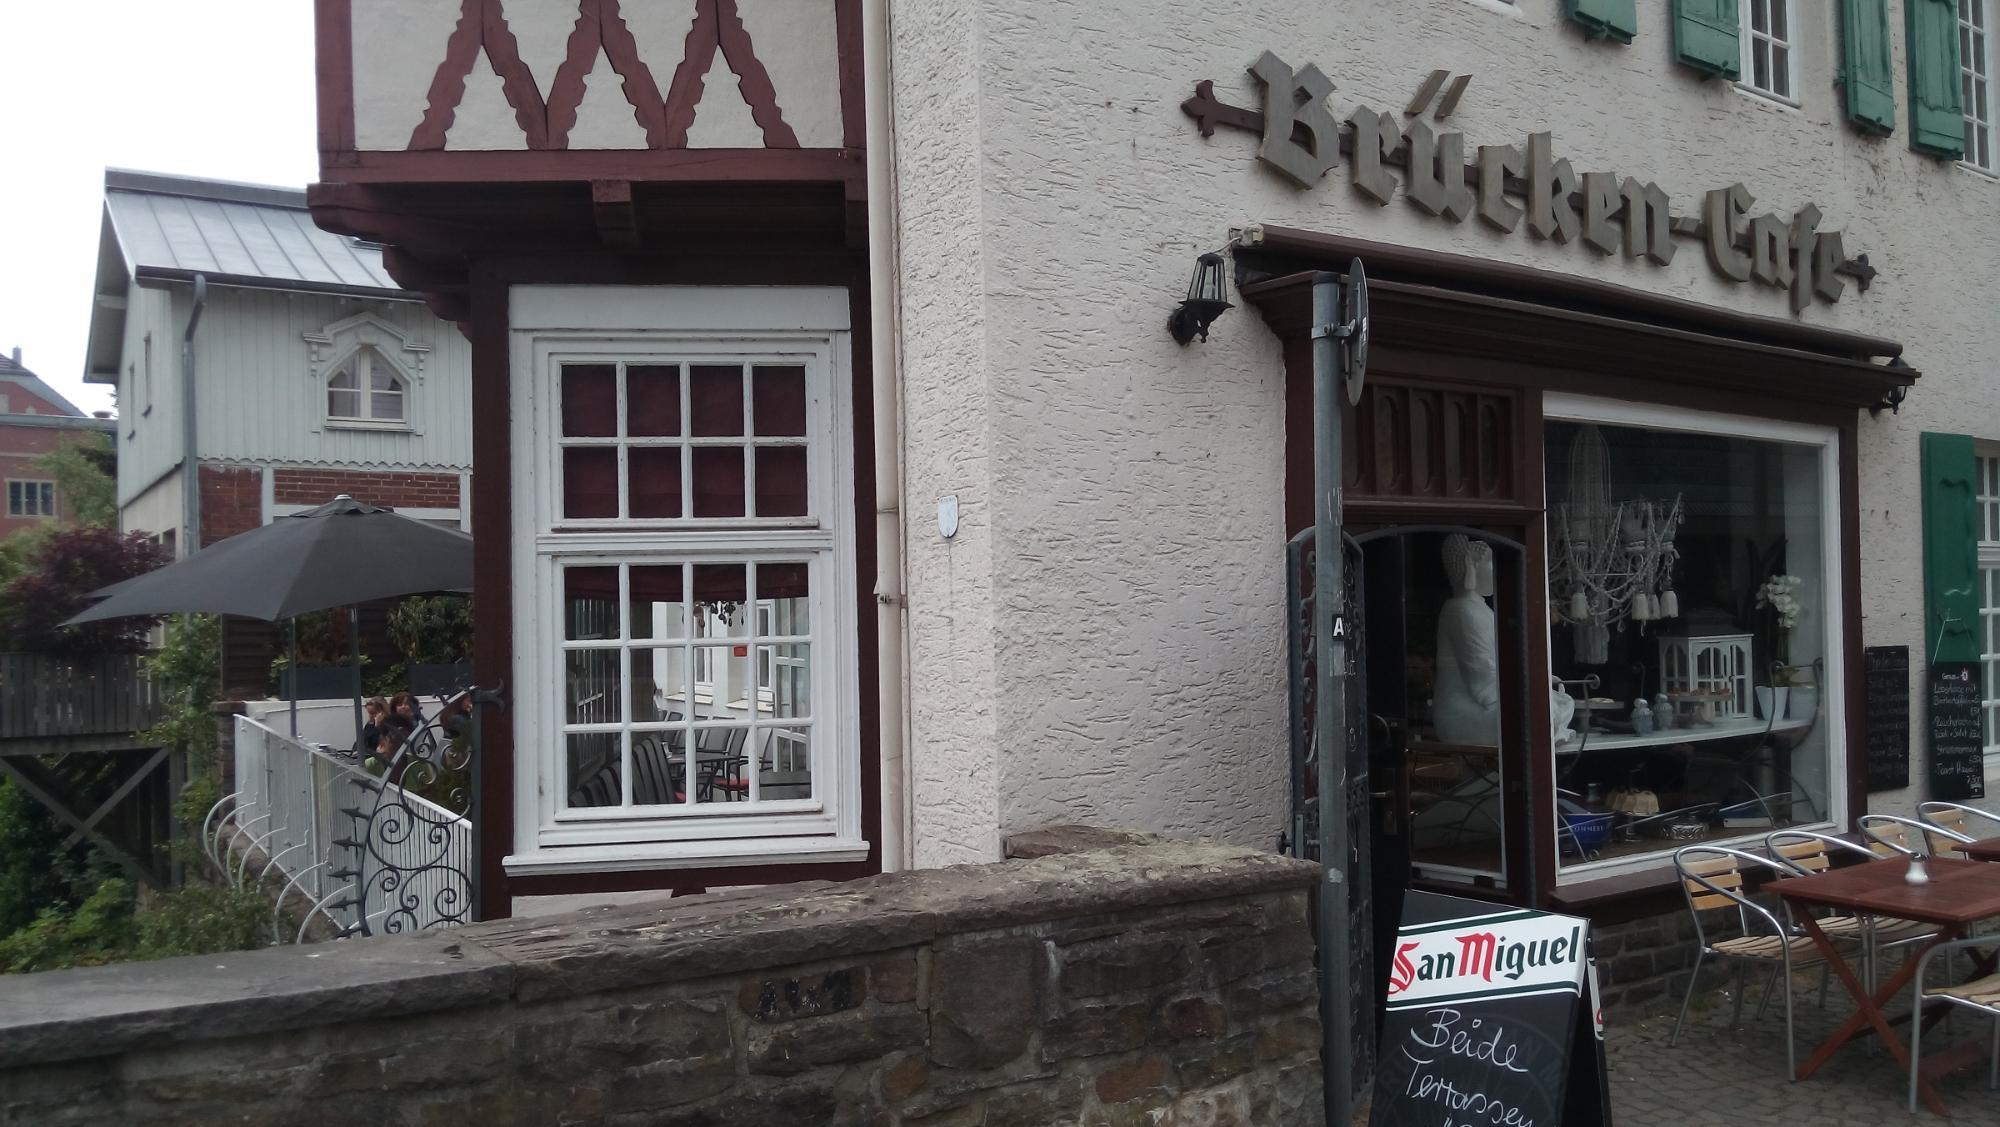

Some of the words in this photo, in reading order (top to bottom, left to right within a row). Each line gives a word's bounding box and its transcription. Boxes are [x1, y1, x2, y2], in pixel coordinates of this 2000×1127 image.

[1387, 941, 1456, 995] San
[1455, 926, 1581, 982] Miguel
[1410, 1007, 1529, 1073] Beide
